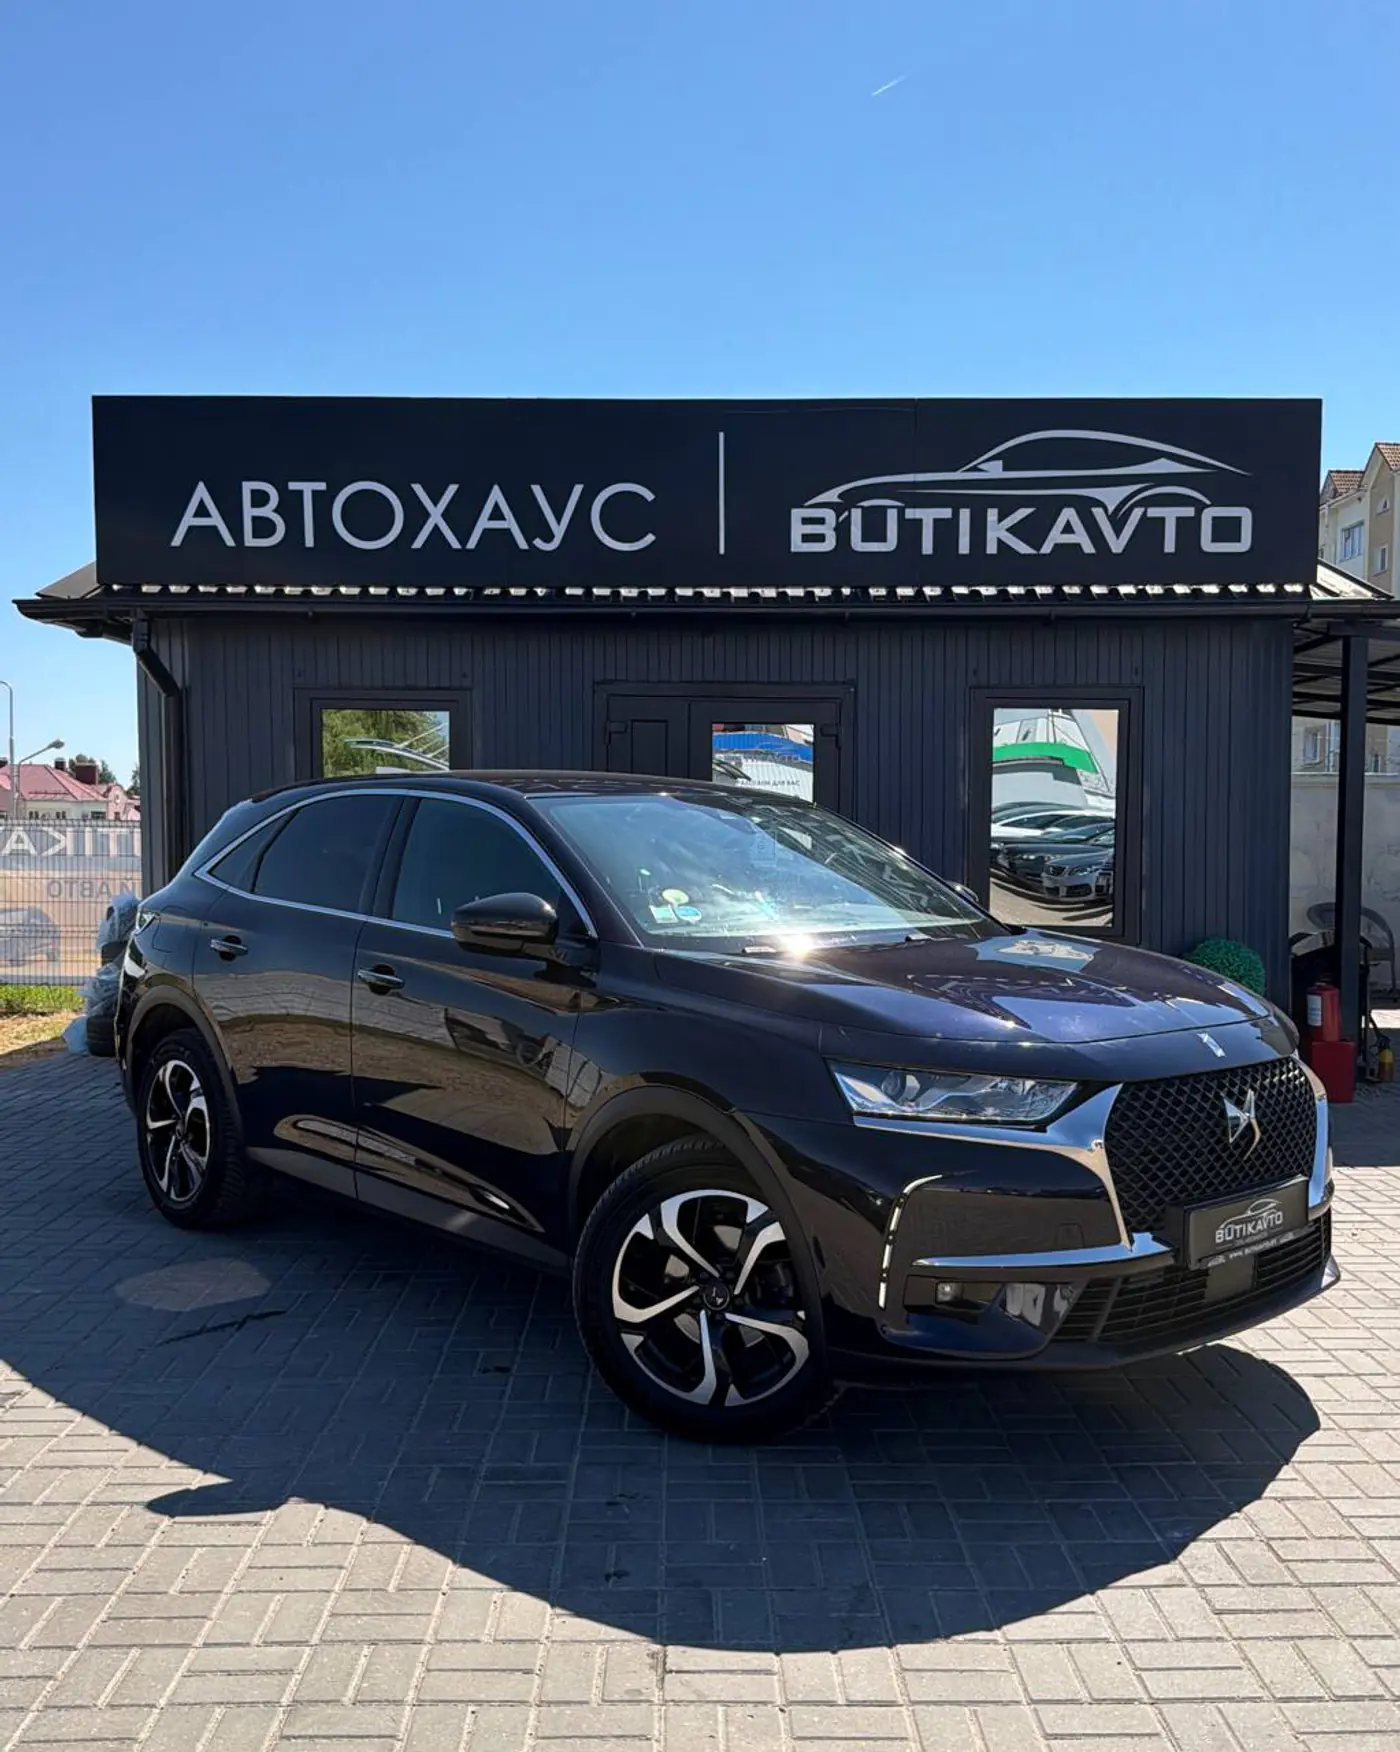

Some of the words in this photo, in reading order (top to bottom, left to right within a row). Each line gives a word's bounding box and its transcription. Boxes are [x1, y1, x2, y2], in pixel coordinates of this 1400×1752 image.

[170, 480, 656, 552] АВТОХАУС
[790, 505, 1253, 555] BUTIKAVTO
[1215, 1211, 1283, 1243] BUTIKAVTO
